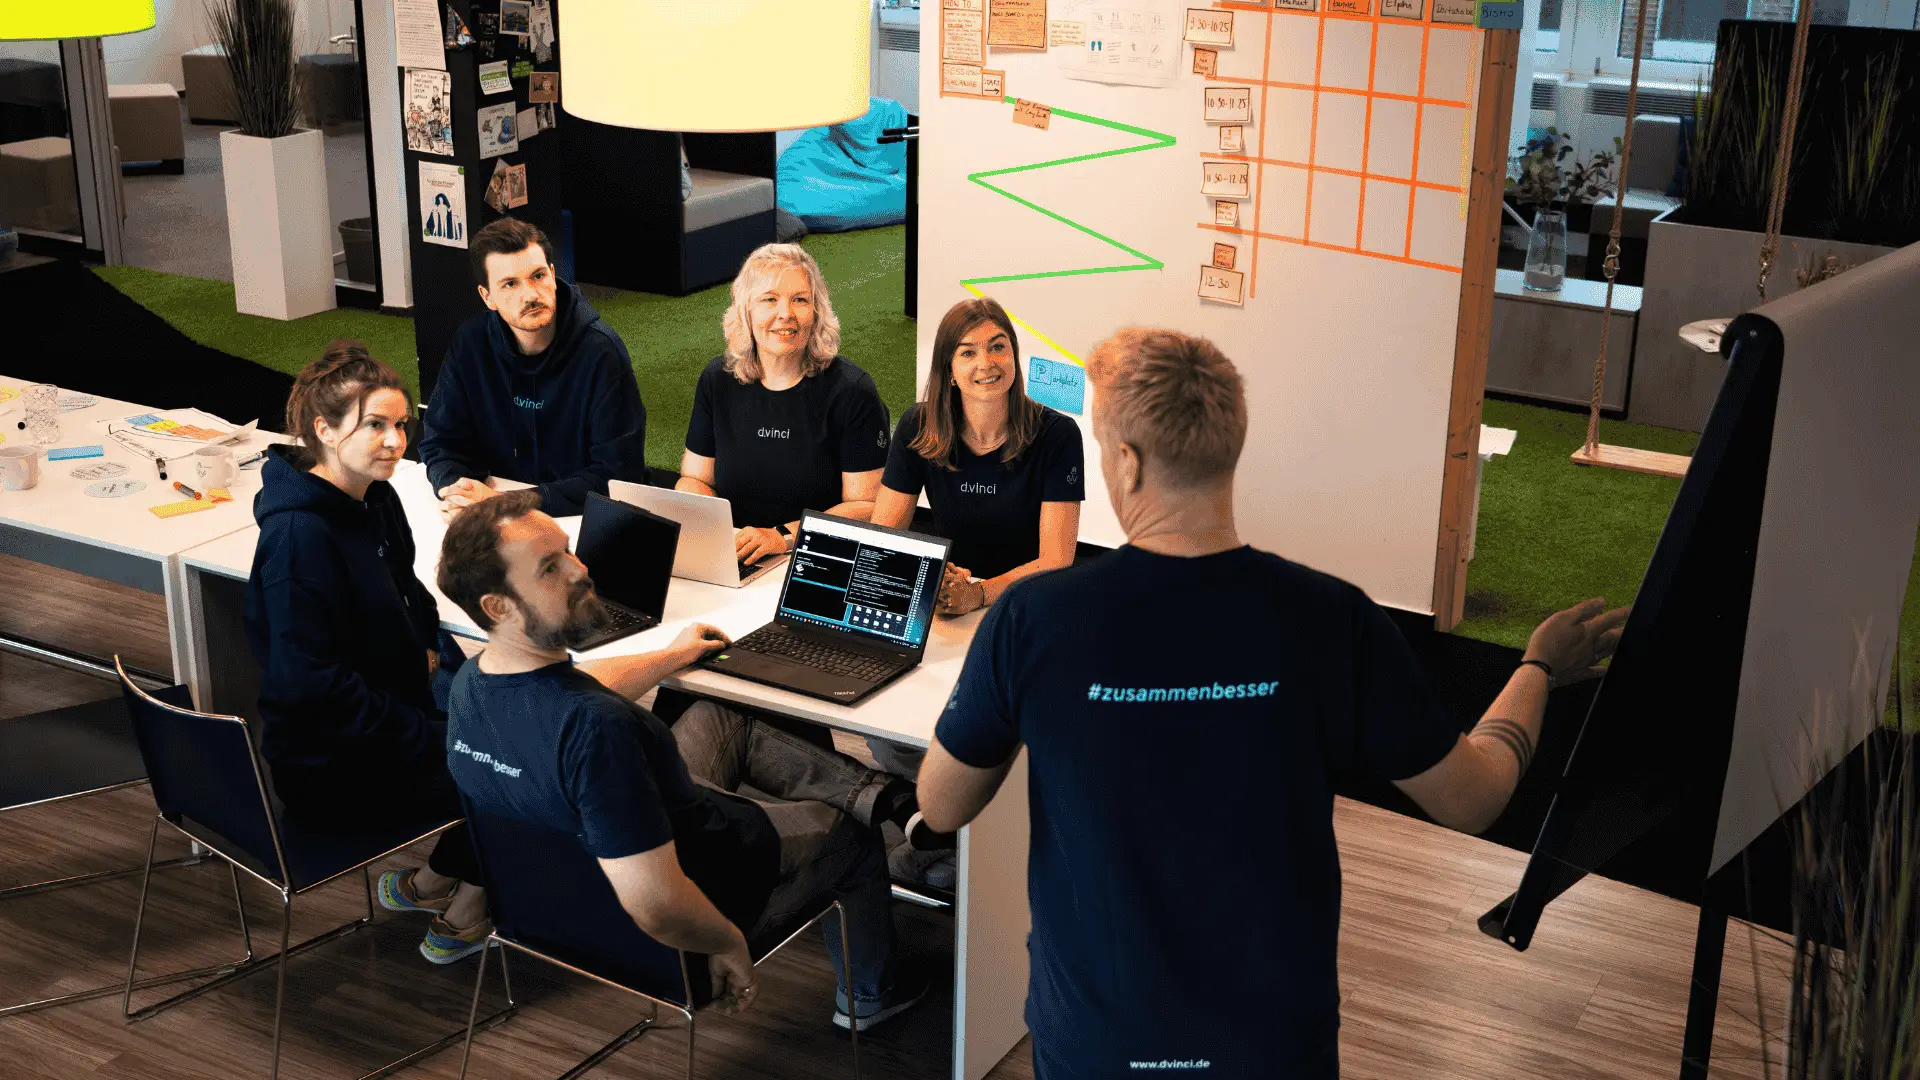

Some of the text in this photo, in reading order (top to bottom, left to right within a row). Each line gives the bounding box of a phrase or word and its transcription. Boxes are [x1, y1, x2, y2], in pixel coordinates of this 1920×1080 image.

[1482, 6, 1514, 17] Bistro
[757, 426, 790, 439] d.vinci
[960, 481, 996, 494] d.vinci
[1087, 681, 1279, 702] #zusammenbesser
[1129, 1058, 1211, 1069] www.dvinci.de
